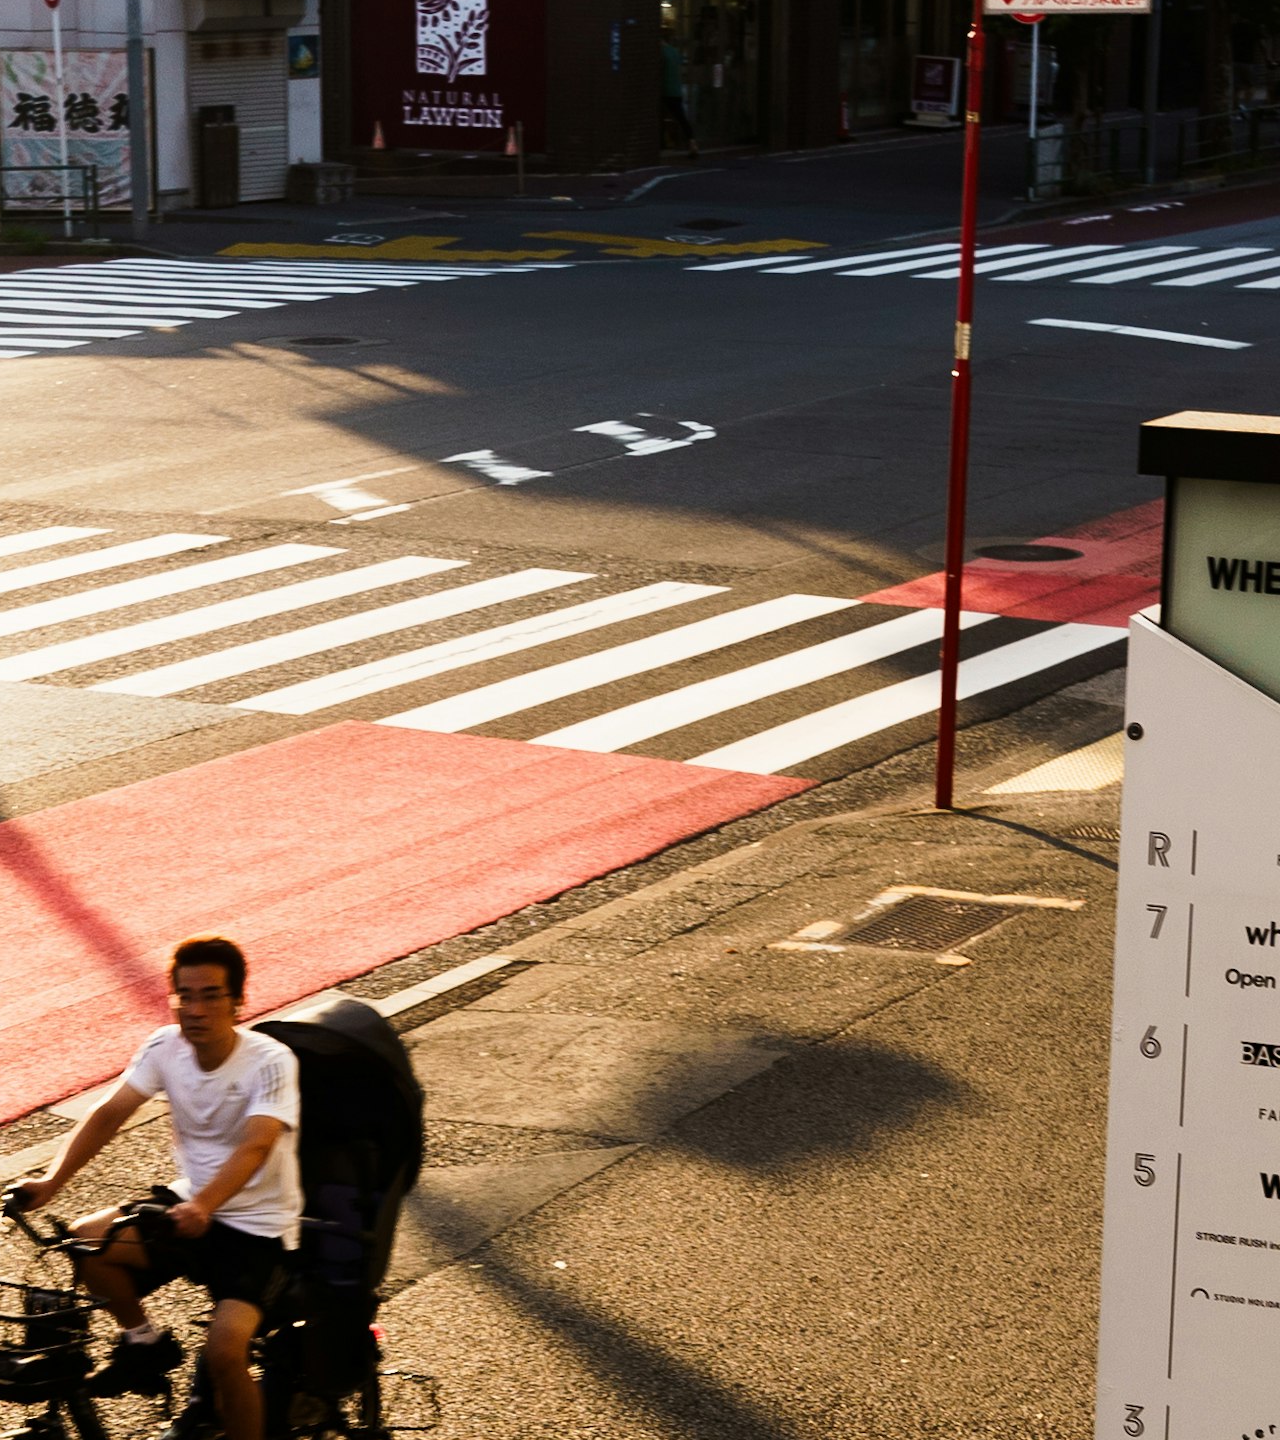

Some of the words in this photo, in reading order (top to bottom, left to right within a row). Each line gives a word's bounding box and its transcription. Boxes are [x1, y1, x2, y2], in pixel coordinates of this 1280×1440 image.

[402, 89, 505, 107] NATURAL
[402, 105, 504, 129] LAWSON
[1148, 830, 1171, 869] R
[1145, 903, 1168, 940] 7
[1225, 966, 1276, 991] Open
[1139, 1024, 1162, 1059] 6
[1132, 1152, 1156, 1188] 5
[1195, 1231, 1237, 1246] STROBE
[1238, 1236, 1268, 1249] RUSH
[1213, 1293, 1246, 1305] STUDIO
[1122, 1403, 1145, 1439] 3
